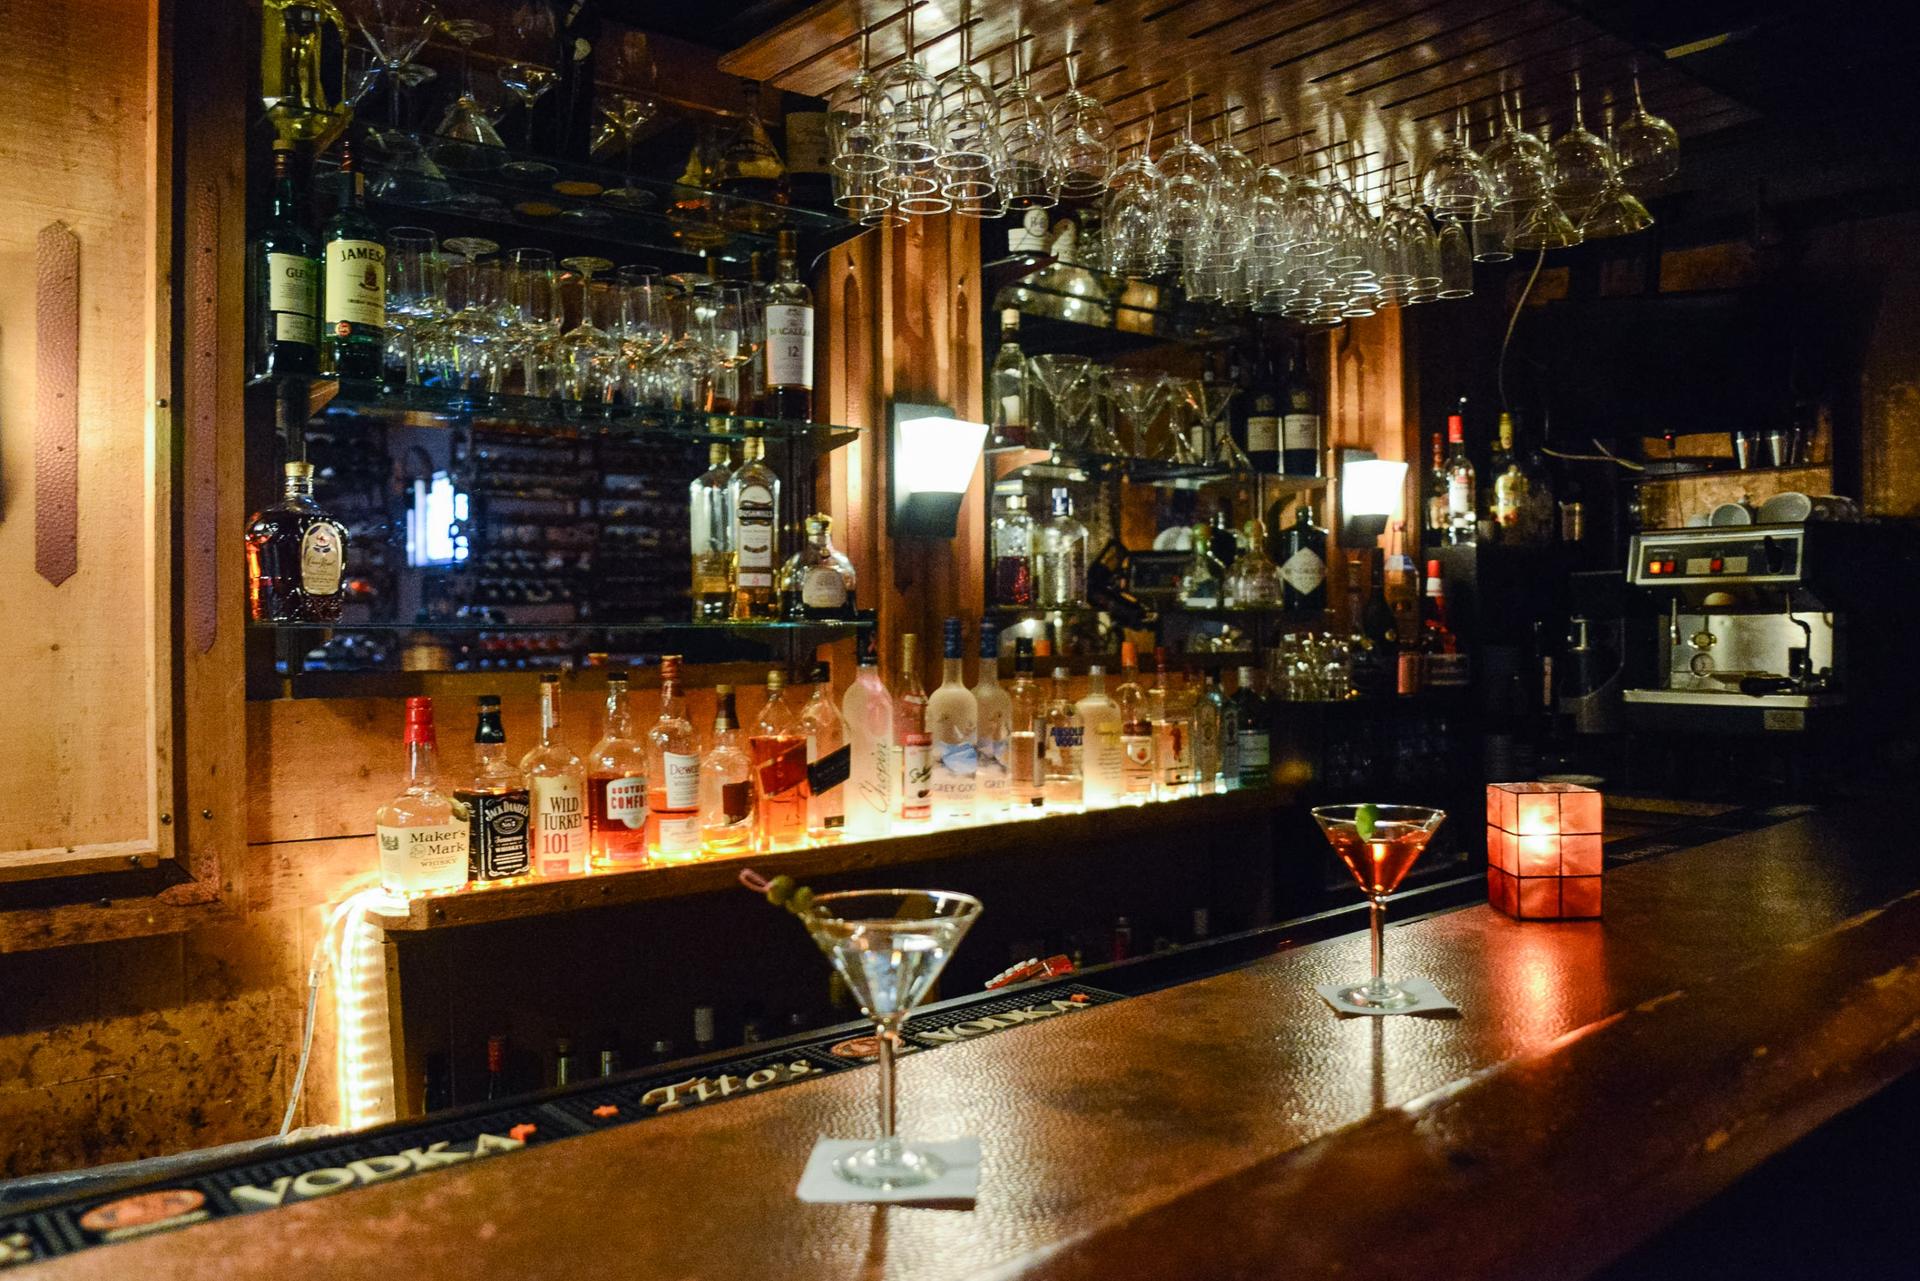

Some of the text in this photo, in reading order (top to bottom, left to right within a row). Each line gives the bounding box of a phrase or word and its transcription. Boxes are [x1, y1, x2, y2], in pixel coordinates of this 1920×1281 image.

[788, 345, 800, 358] 12
[670, 763, 699, 776] Dewa
[549, 796, 580, 813] WILD
[409, 830, 467, 844] Maker's
[543, 833, 568, 854] 101
[427, 841, 466, 856] Mark
[914, 999, 1093, 1042] VODKA
[229, 1132, 526, 1206] VODKA
